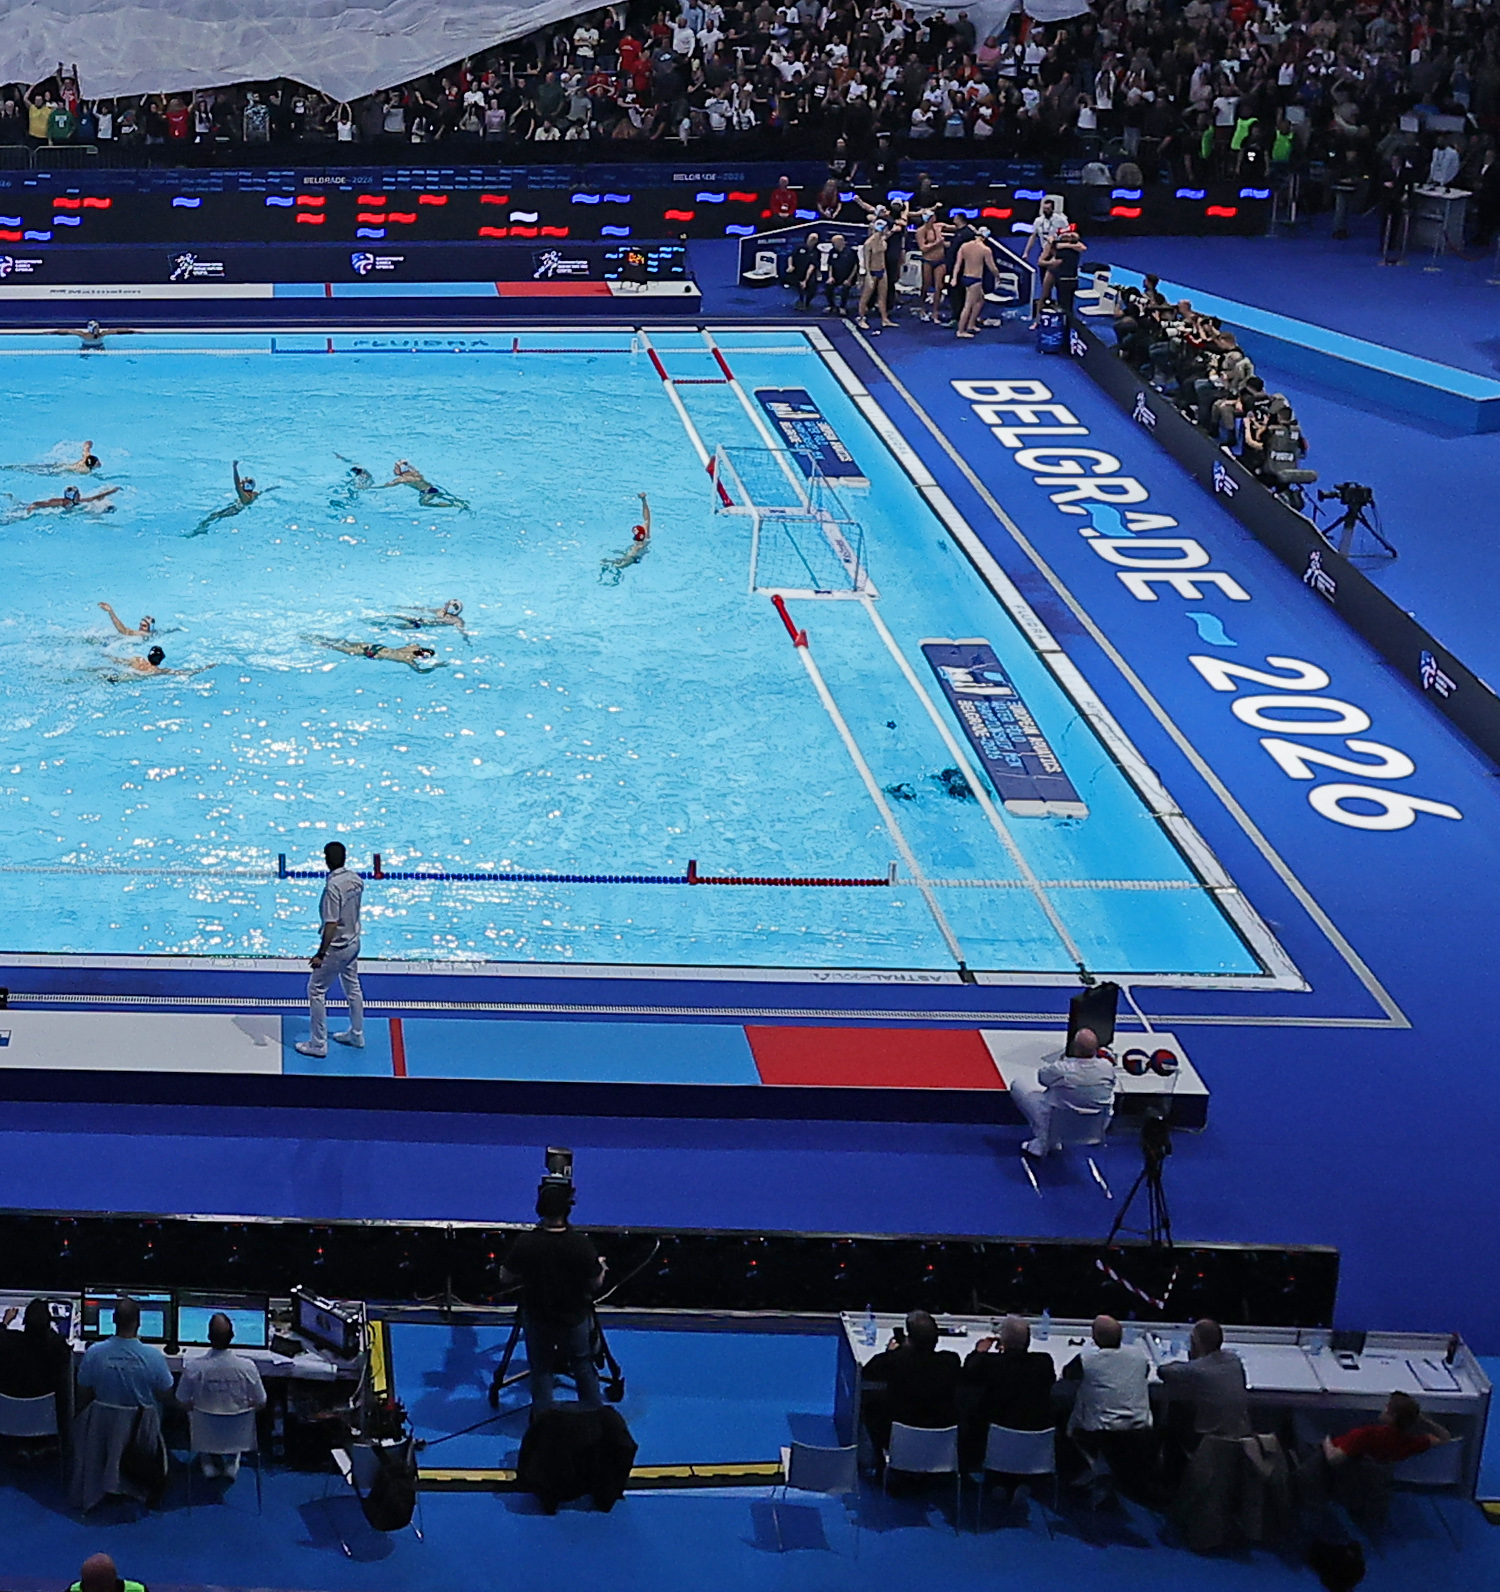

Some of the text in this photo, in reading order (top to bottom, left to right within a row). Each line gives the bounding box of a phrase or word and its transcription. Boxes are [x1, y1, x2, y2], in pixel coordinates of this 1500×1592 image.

[950, 378, 1463, 832] BELGRADE 2026
[956, 699, 989, 738] BELGRADE
